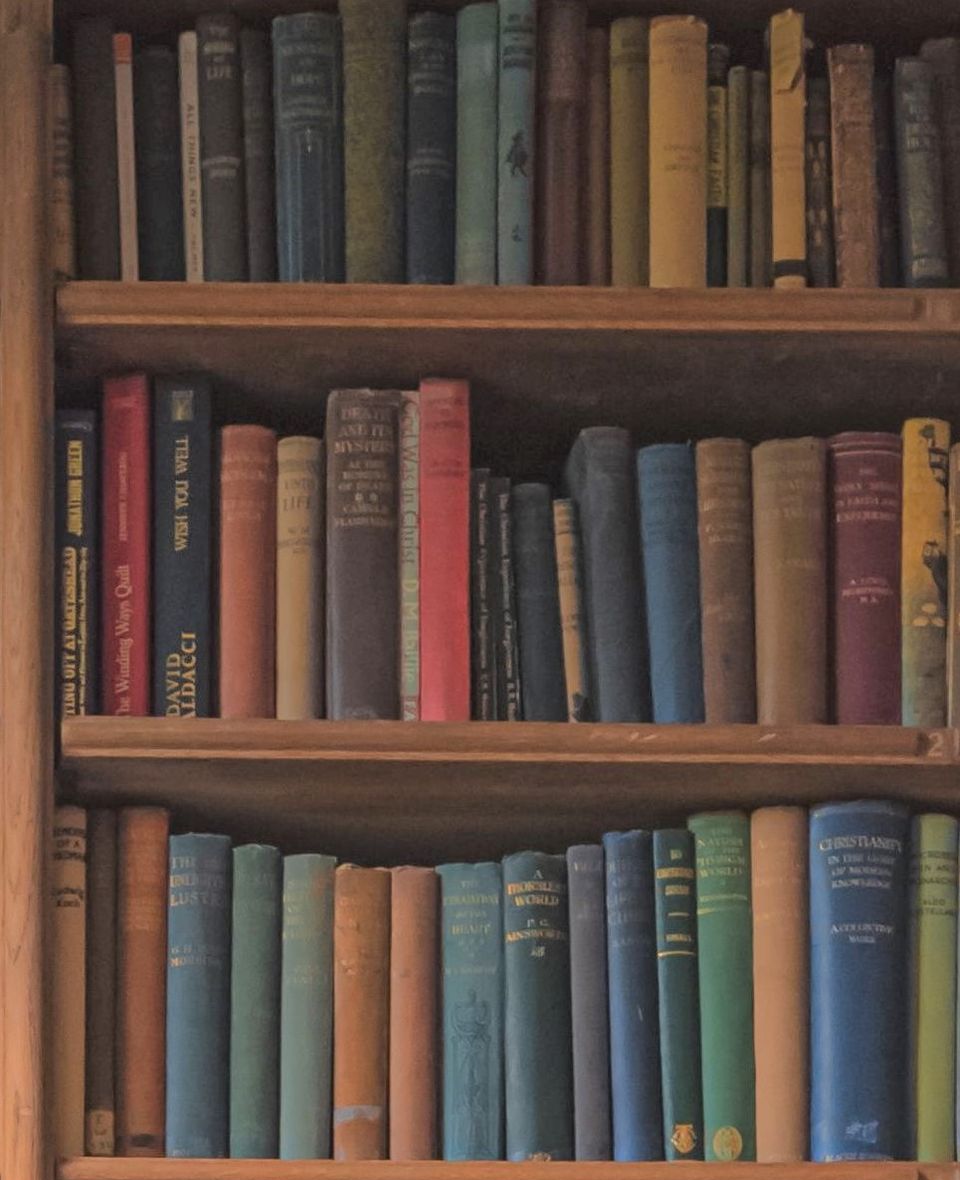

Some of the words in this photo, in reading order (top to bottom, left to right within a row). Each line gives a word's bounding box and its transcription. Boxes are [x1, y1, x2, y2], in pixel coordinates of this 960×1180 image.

[174, 435, 189, 474] WELL
[174, 480, 189, 514] YOU
[174, 516, 189, 551] WISH
[115, 564, 132, 599] Quilt
[116, 600, 133, 637] Ways
[116, 637, 133, 693] Winding
[166, 653, 181, 717] DAVID
[818, 835, 903, 853] CHRISTIANITY
